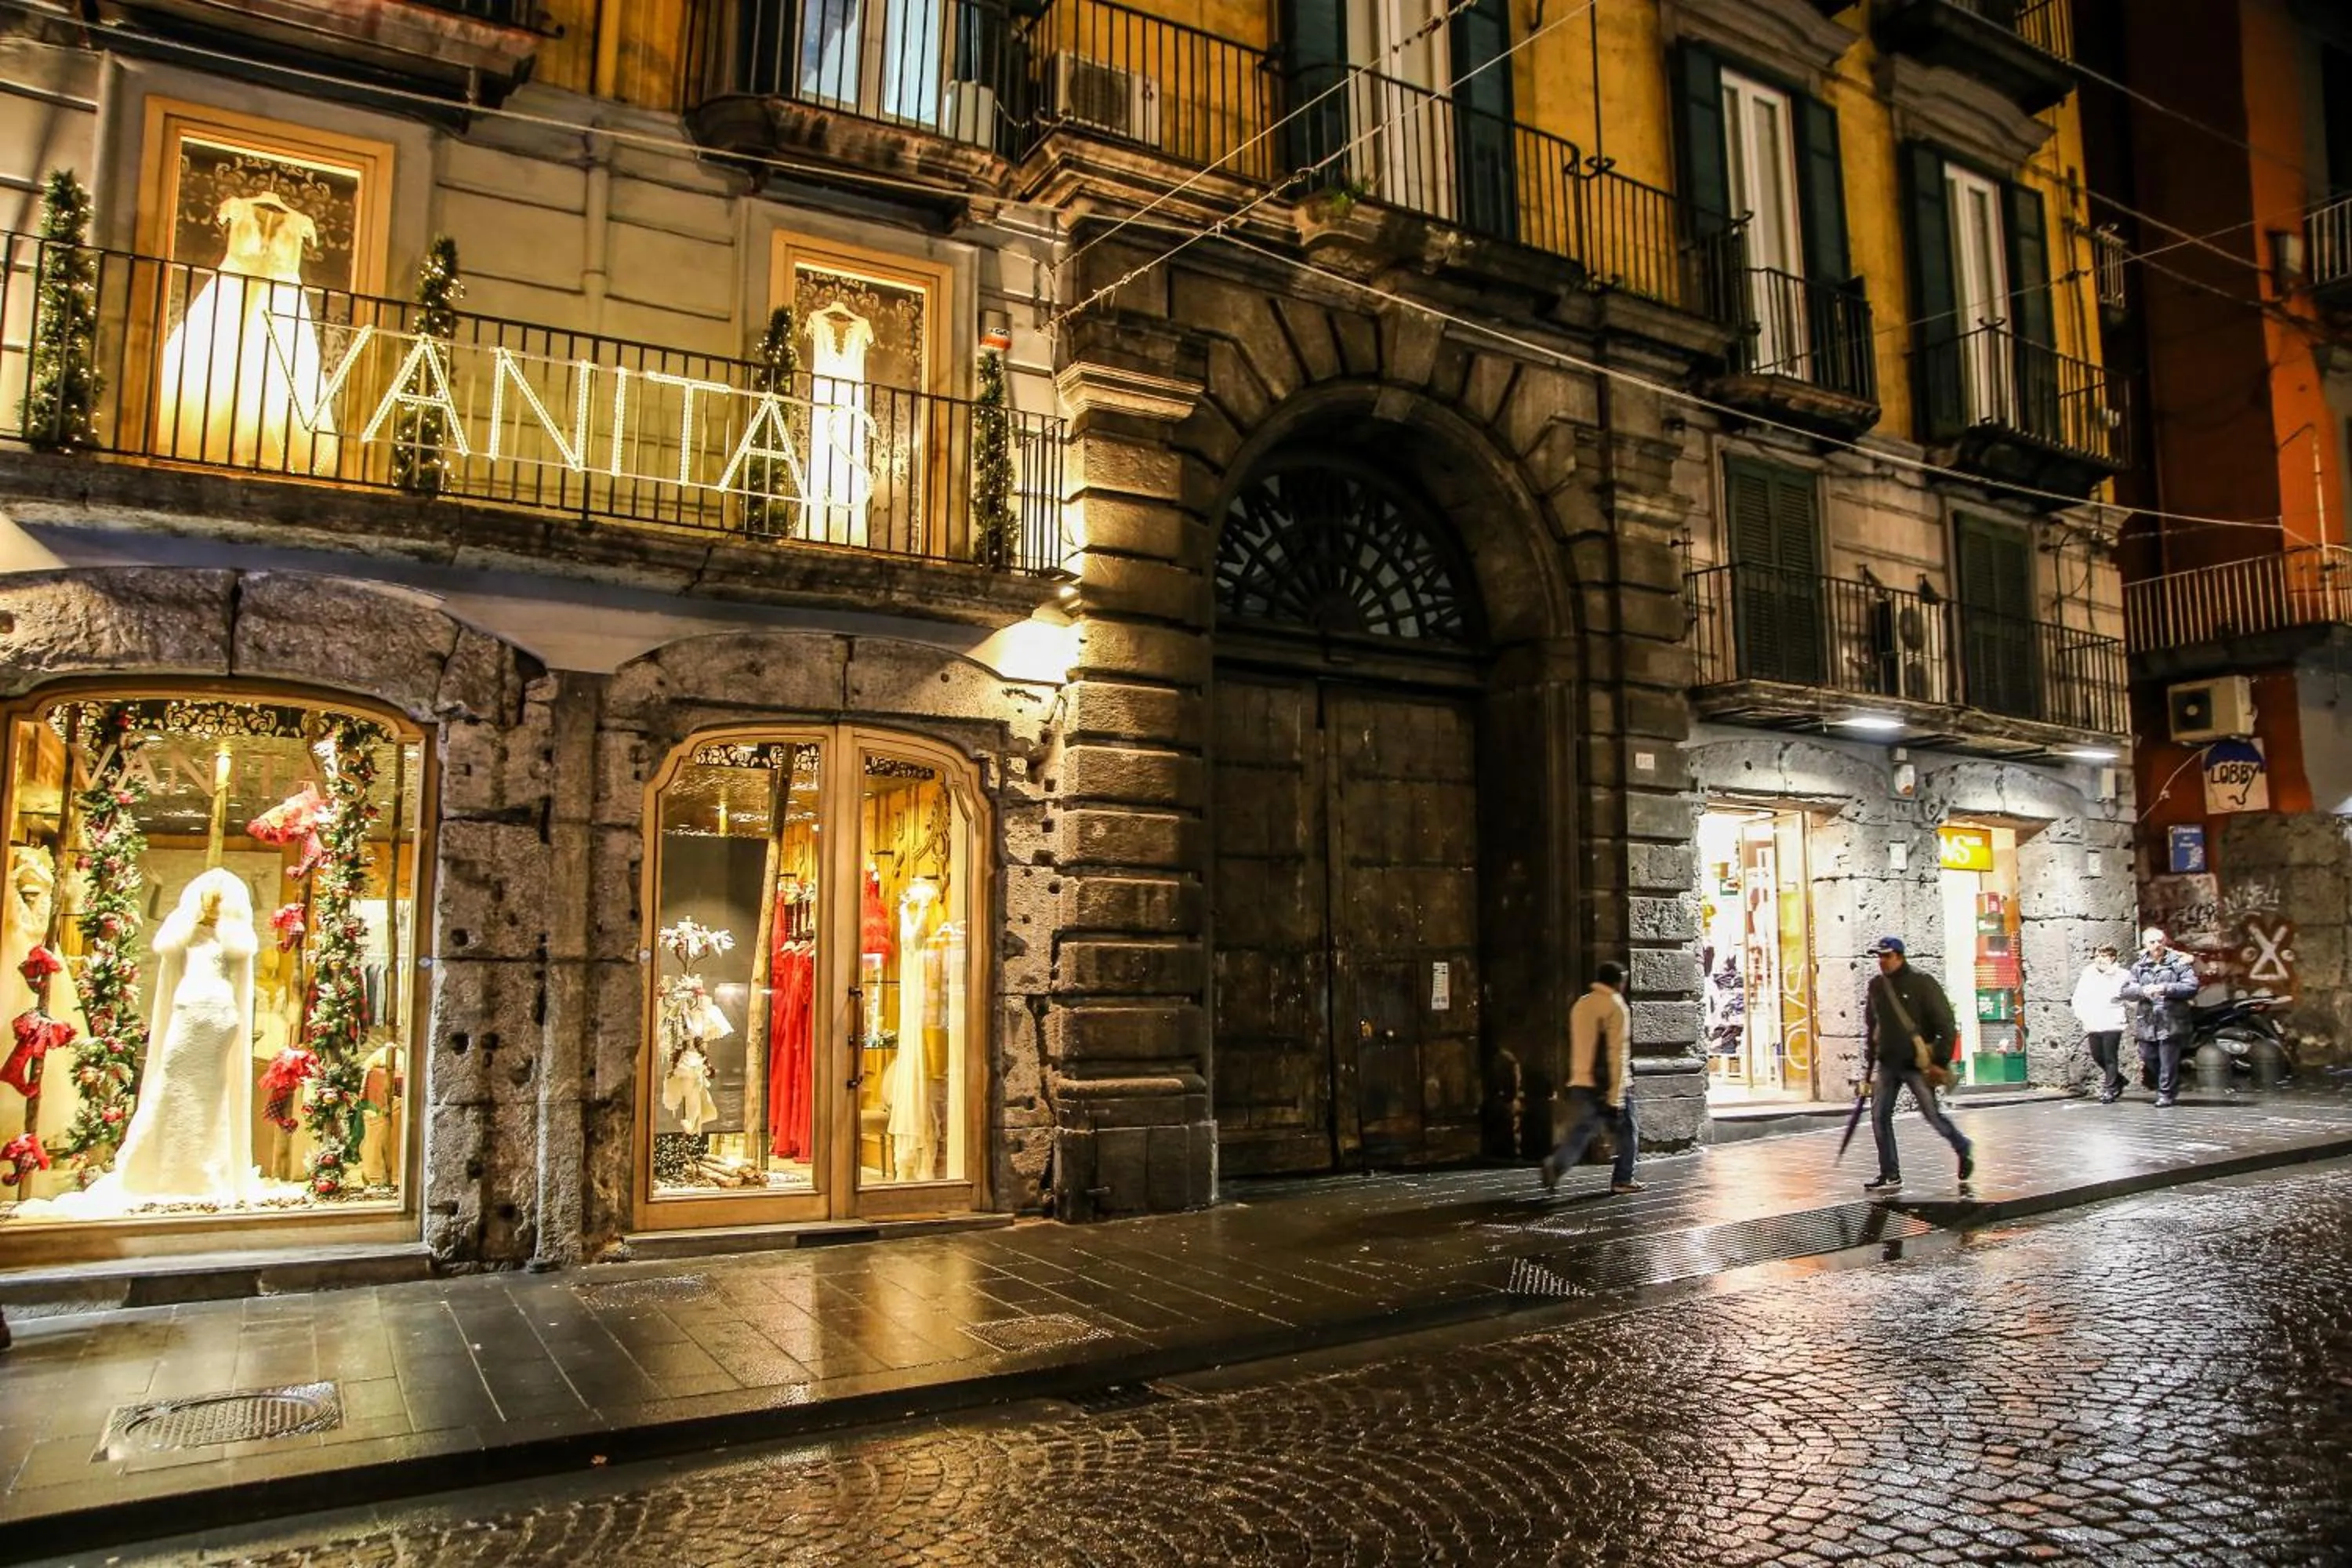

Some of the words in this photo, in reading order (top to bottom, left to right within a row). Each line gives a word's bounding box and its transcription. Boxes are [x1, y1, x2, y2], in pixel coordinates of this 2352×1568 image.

[262, 310, 879, 510] VANITAS
[66, 742, 366, 803] VANITAS
[2211, 764, 2259, 805] LOBBY
